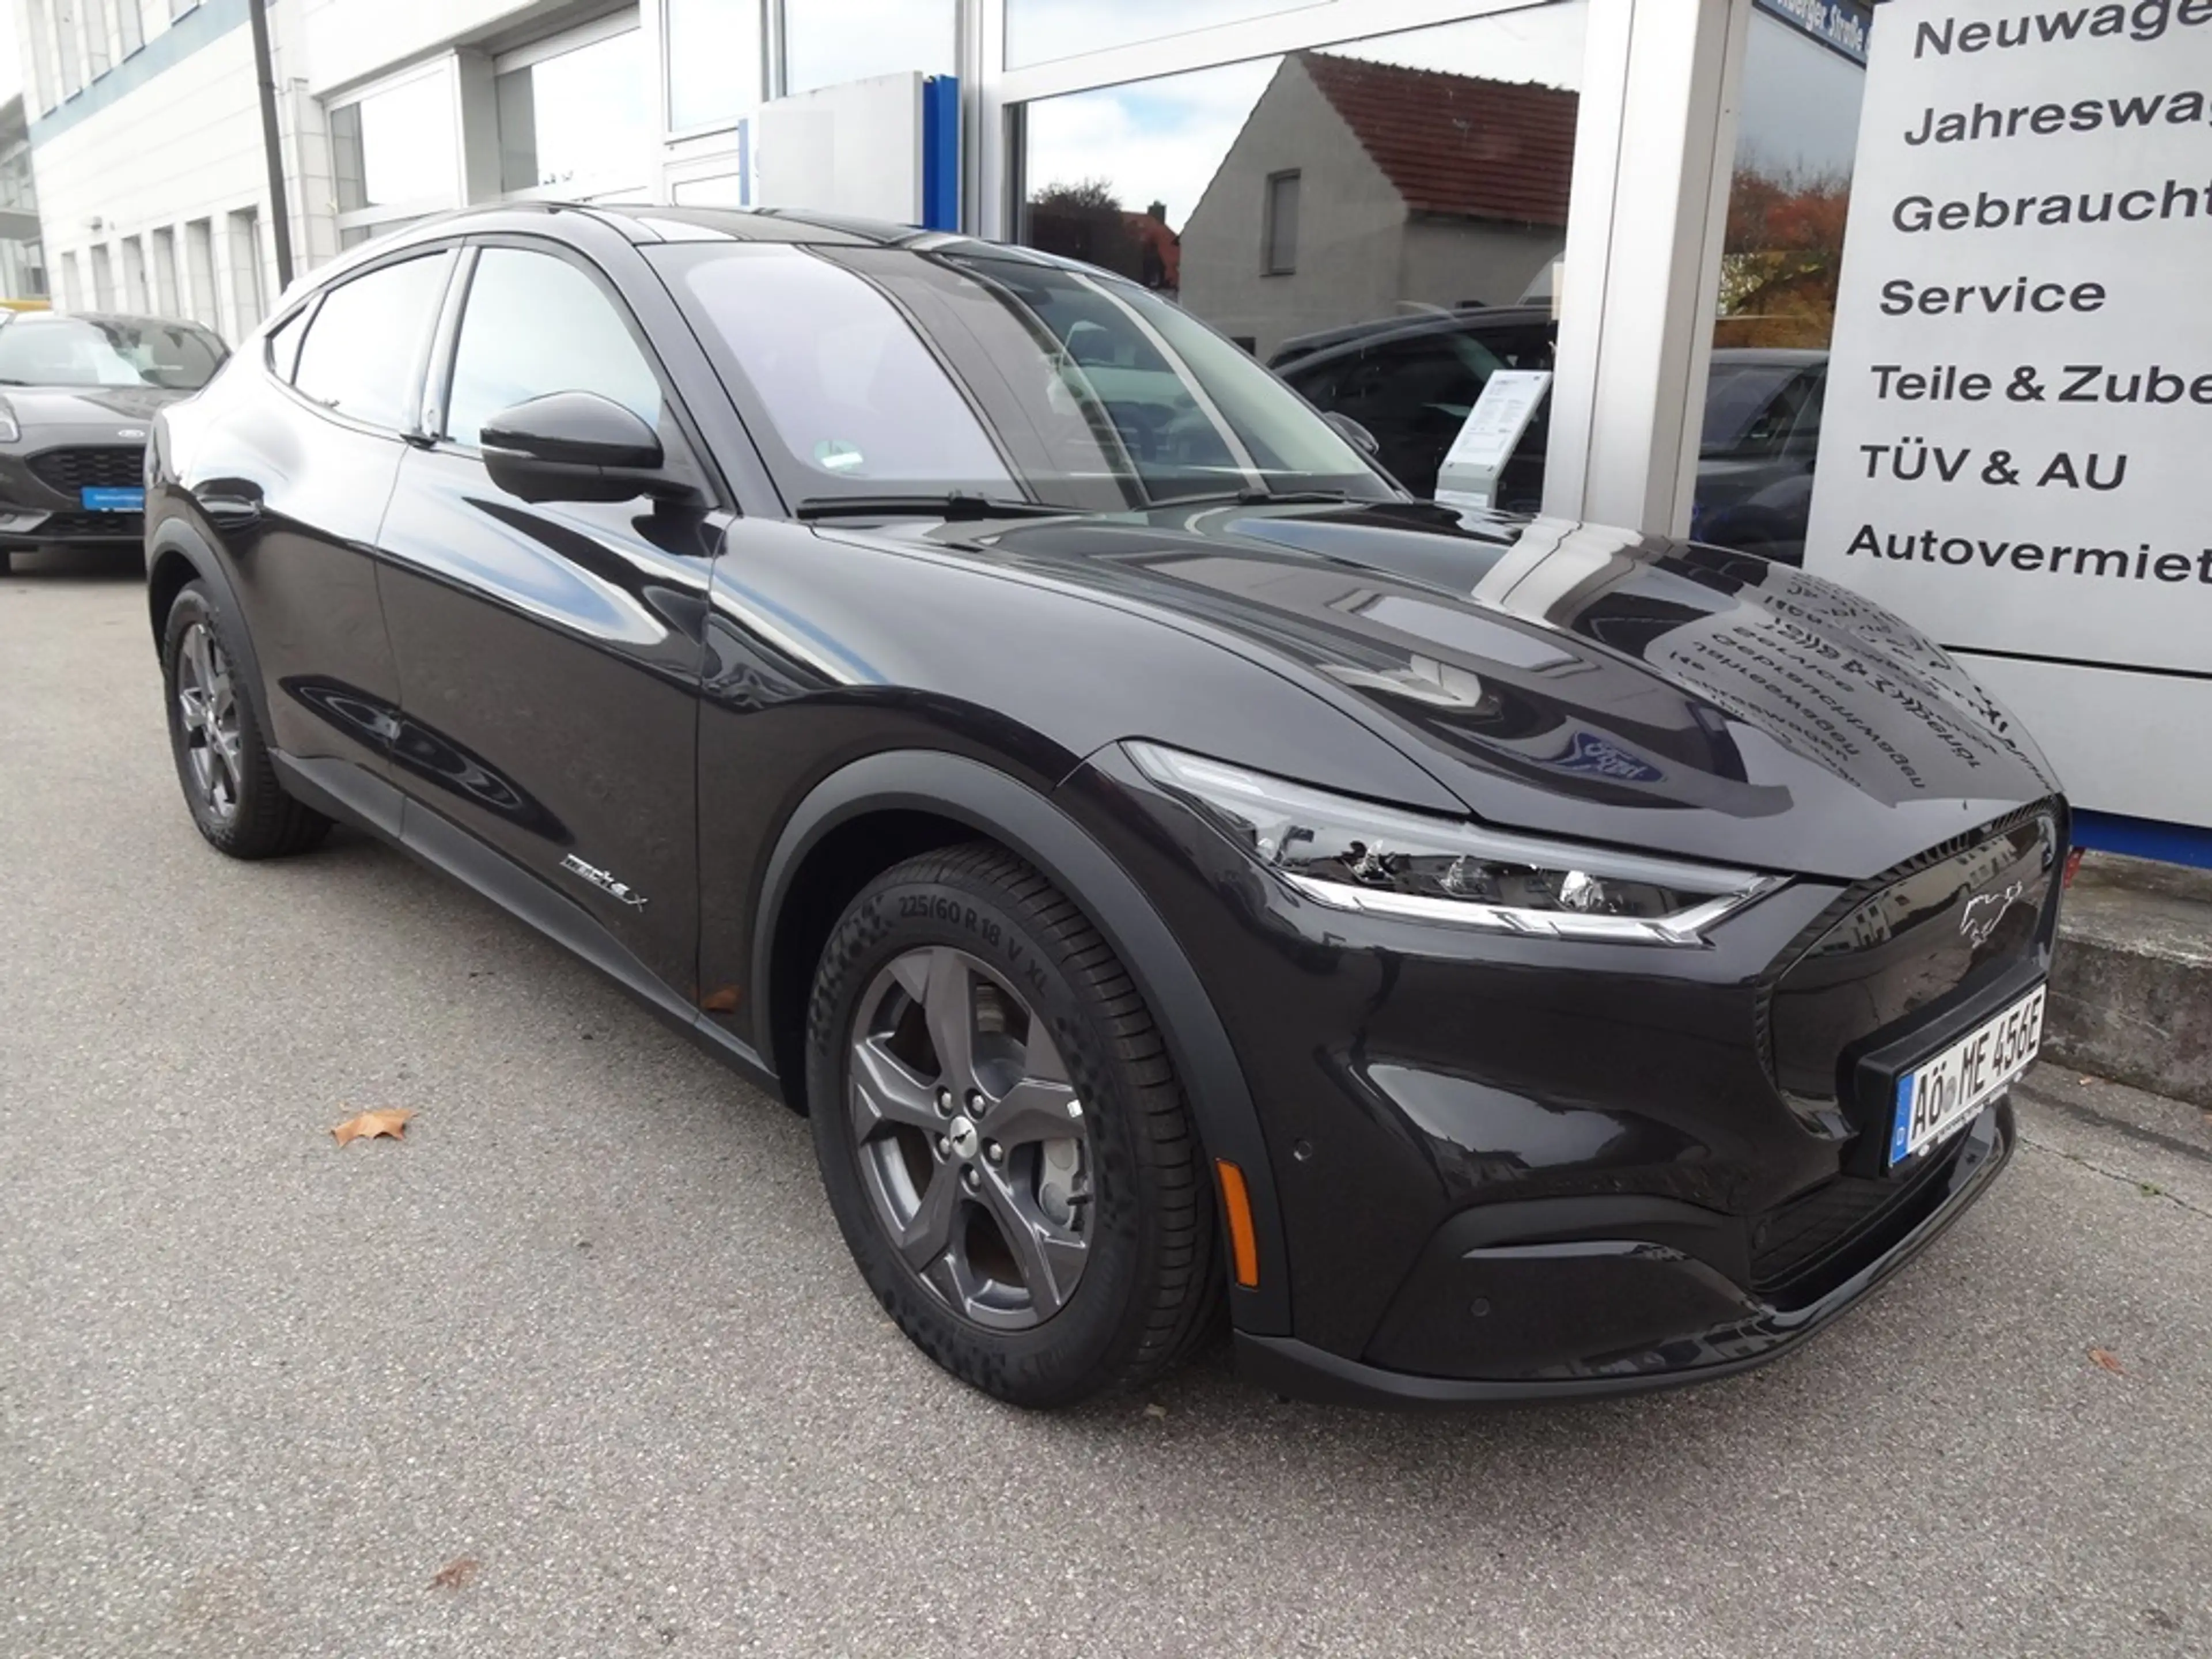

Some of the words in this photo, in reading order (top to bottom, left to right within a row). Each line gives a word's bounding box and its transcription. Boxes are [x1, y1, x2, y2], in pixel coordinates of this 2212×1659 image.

[1914, 0, 2212, 59] Neuwage
[1904, 90, 2212, 146] Jahreswa
[1880, 277, 2105, 316] Service
[1871, 365, 1992, 402] Teile
[2006, 365, 2046, 402] &
[2059, 365, 2212, 404] Zube
[1860, 437, 1971, 482] TÜV
[1982, 450, 2020, 486] &
[2037, 454, 2127, 491] AU
[1847, 524, 2212, 584] Autovermiet
[898, 894, 961, 924] 225/60
[965, 908, 978, 932] R
[981, 918, 1001, 946] 18
[1009, 937, 1023, 961] V
[1911, 1060, 1948, 1140] AÖ
[1959, 1031, 1990, 1105] ME
[1992, 994, 2043, 1077] 456E
